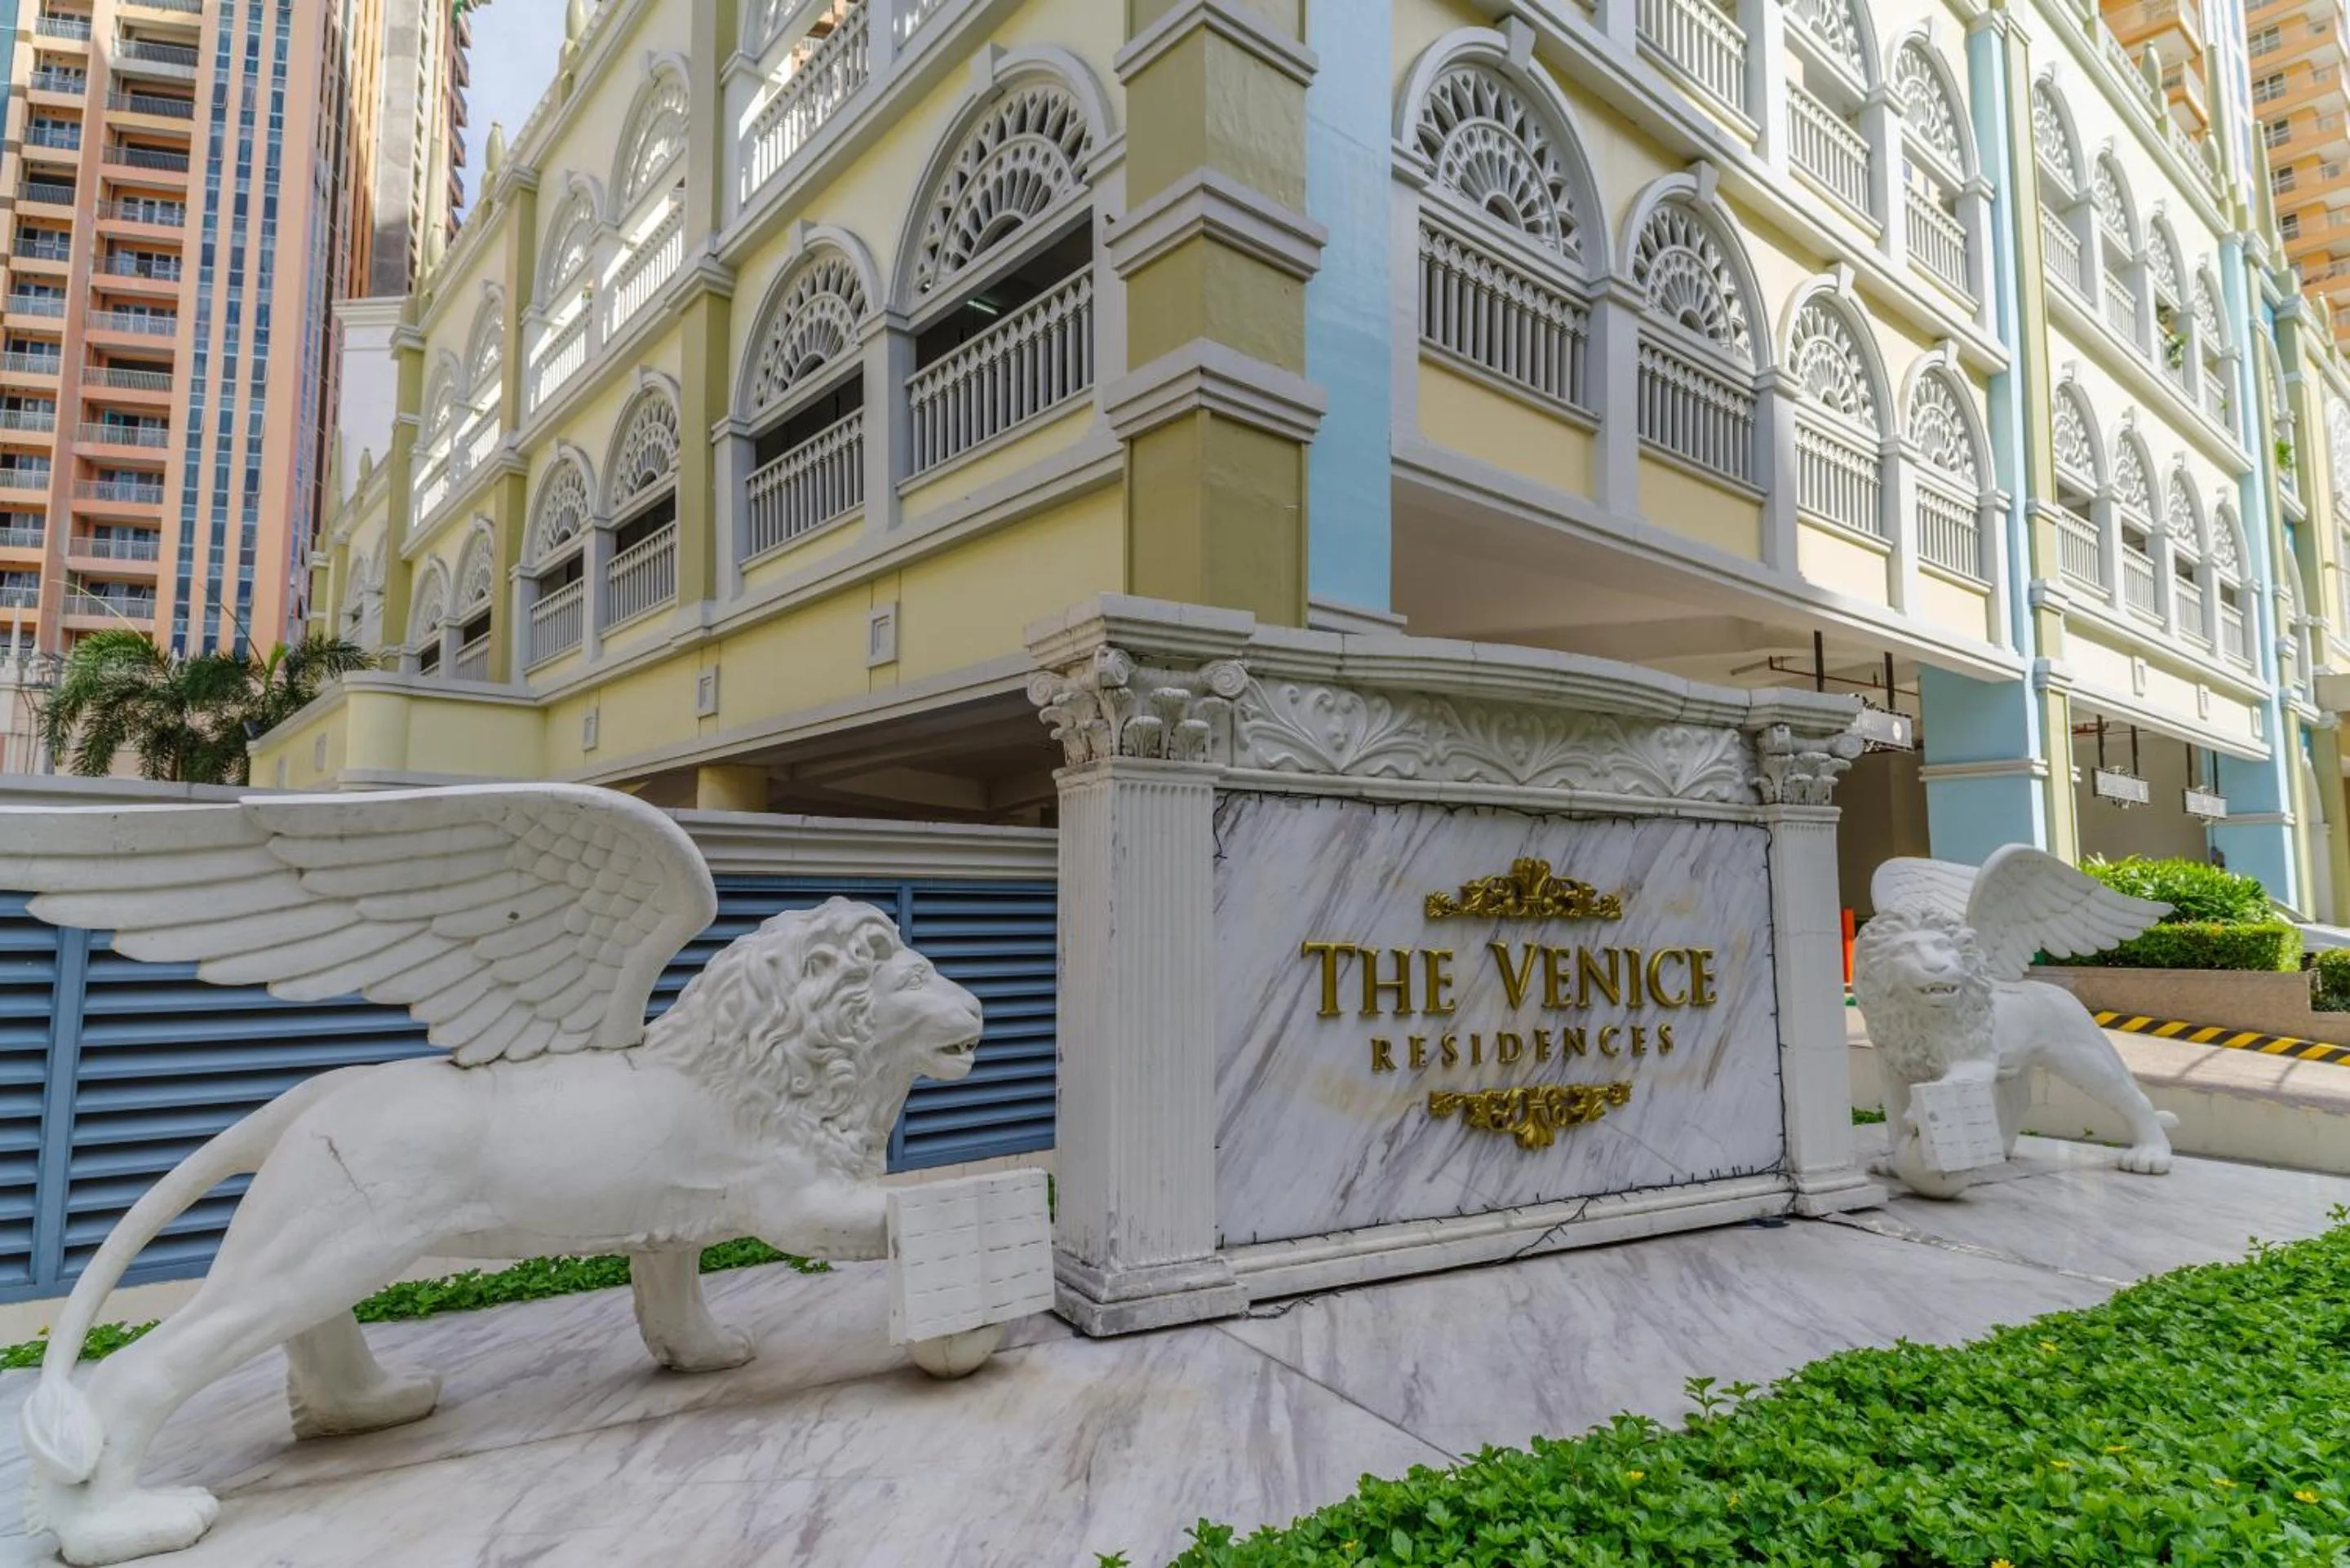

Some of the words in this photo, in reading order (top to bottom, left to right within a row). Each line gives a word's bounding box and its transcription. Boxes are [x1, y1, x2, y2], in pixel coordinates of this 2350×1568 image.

[1301, 940, 1456, 1017] THE
[1488, 941, 1718, 1010] VENICE
[1370, 1022, 1674, 1074] RESIDENCES
